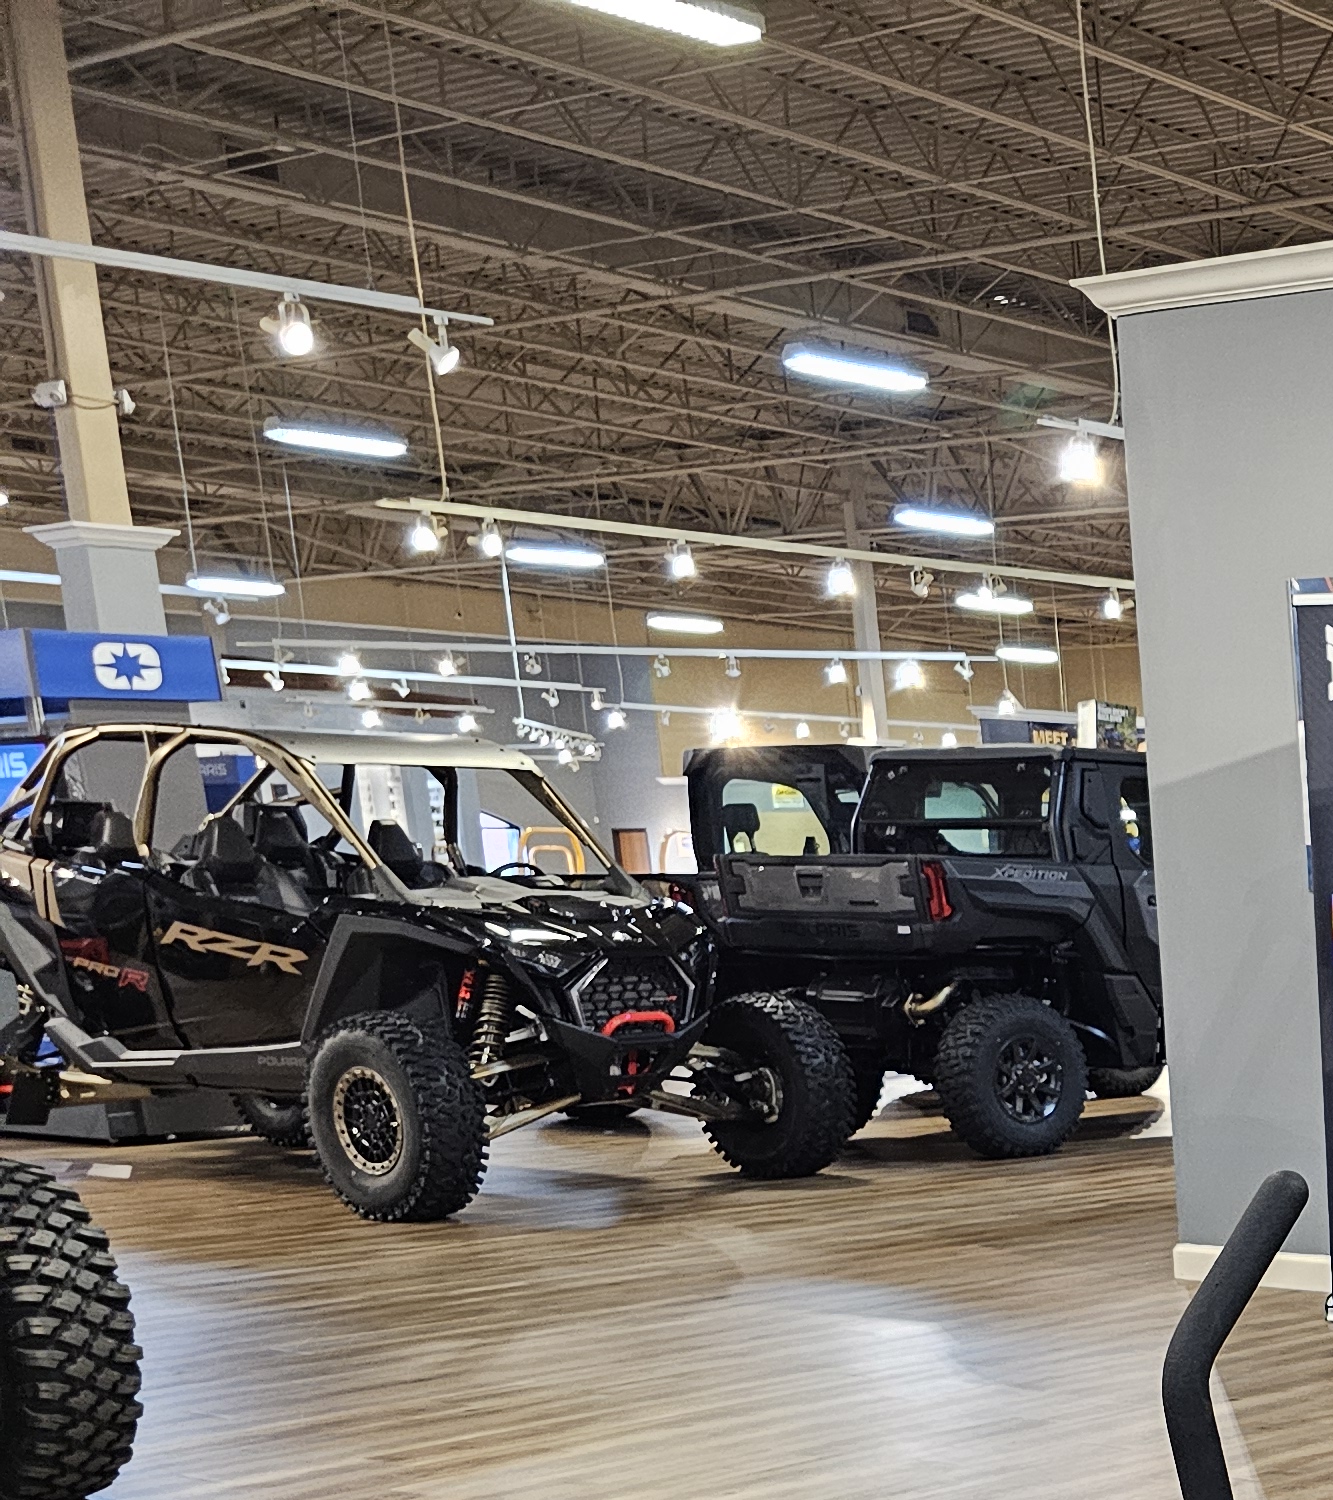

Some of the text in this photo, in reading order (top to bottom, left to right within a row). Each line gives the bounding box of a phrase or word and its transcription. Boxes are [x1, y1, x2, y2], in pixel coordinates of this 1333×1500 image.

[990, 864, 1068, 881] XPEDITION
[160, 921, 308, 975] RZR
[74, 957, 149, 992] PRO R
